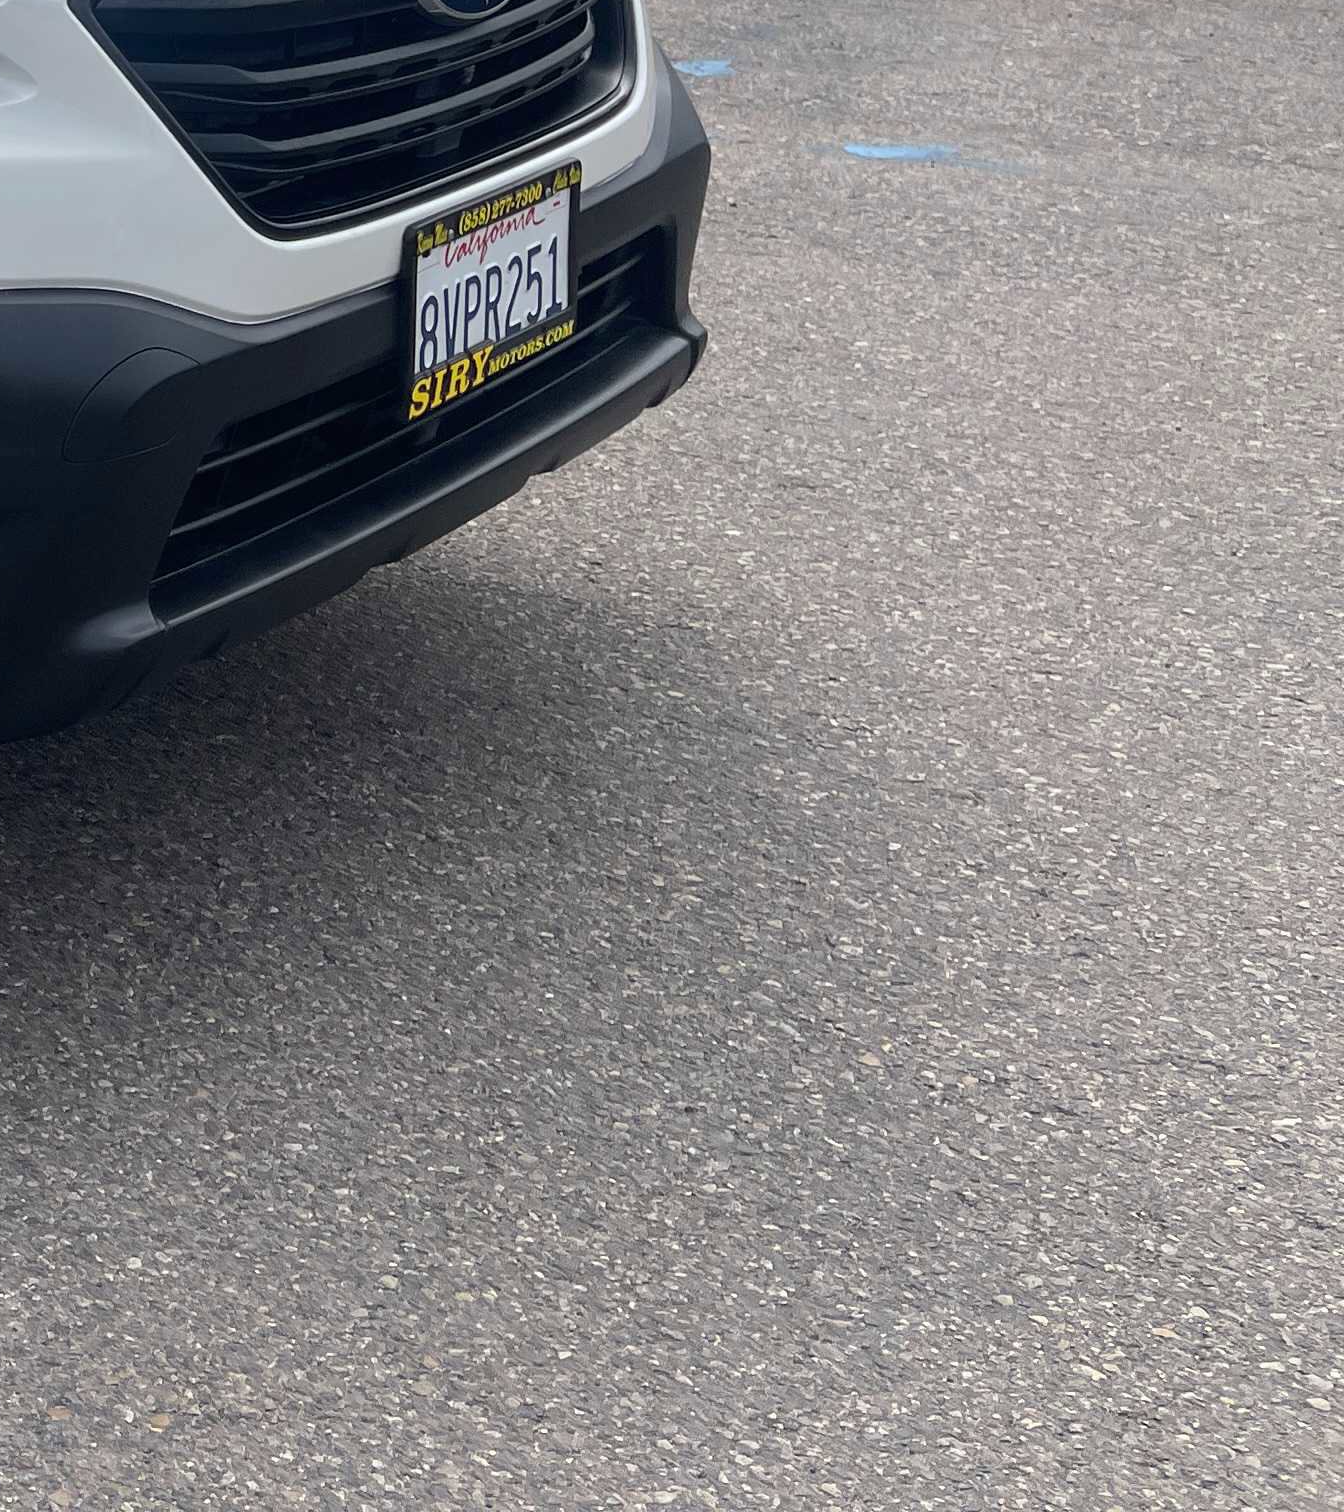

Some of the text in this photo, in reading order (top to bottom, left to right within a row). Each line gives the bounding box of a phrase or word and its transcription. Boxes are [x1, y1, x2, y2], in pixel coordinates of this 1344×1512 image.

[444, 206, 546, 268] California
[419, 236, 562, 374] 8VPR251
[408, 319, 576, 421] SIRY MOTORS.COM
